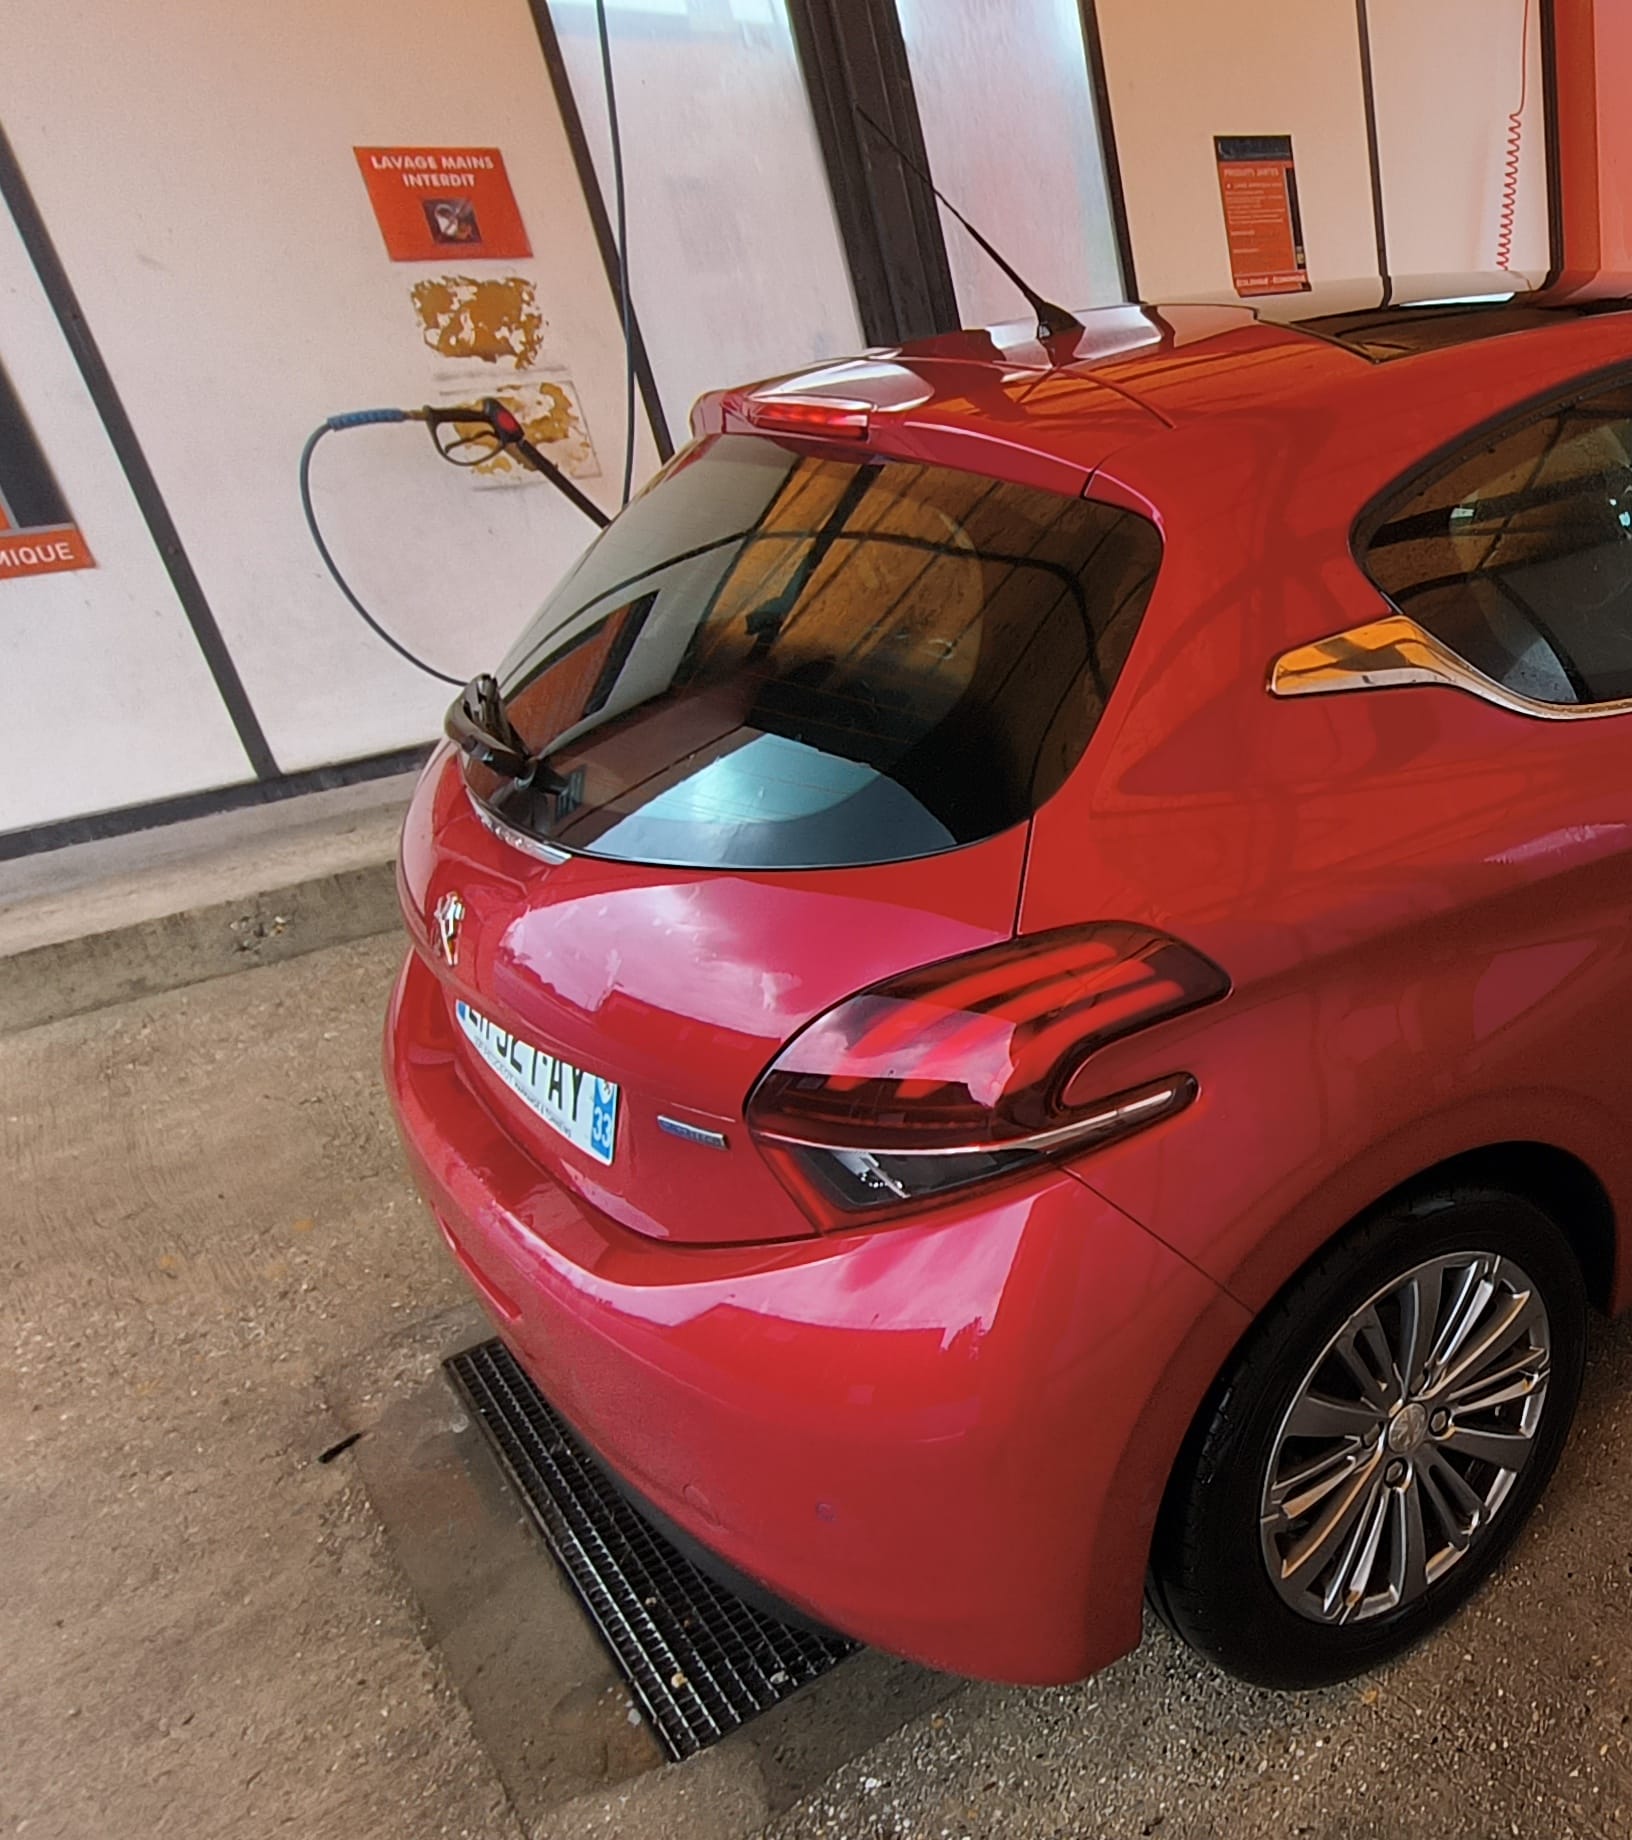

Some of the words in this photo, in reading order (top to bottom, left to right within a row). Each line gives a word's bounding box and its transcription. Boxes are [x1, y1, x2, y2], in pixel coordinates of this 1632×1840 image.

[370, 155, 438, 170] LAVAGE
[441, 155, 494, 169] MAINS
[402, 173, 475, 187] INTERDIT
[593, 1106, 612, 1148] 33
